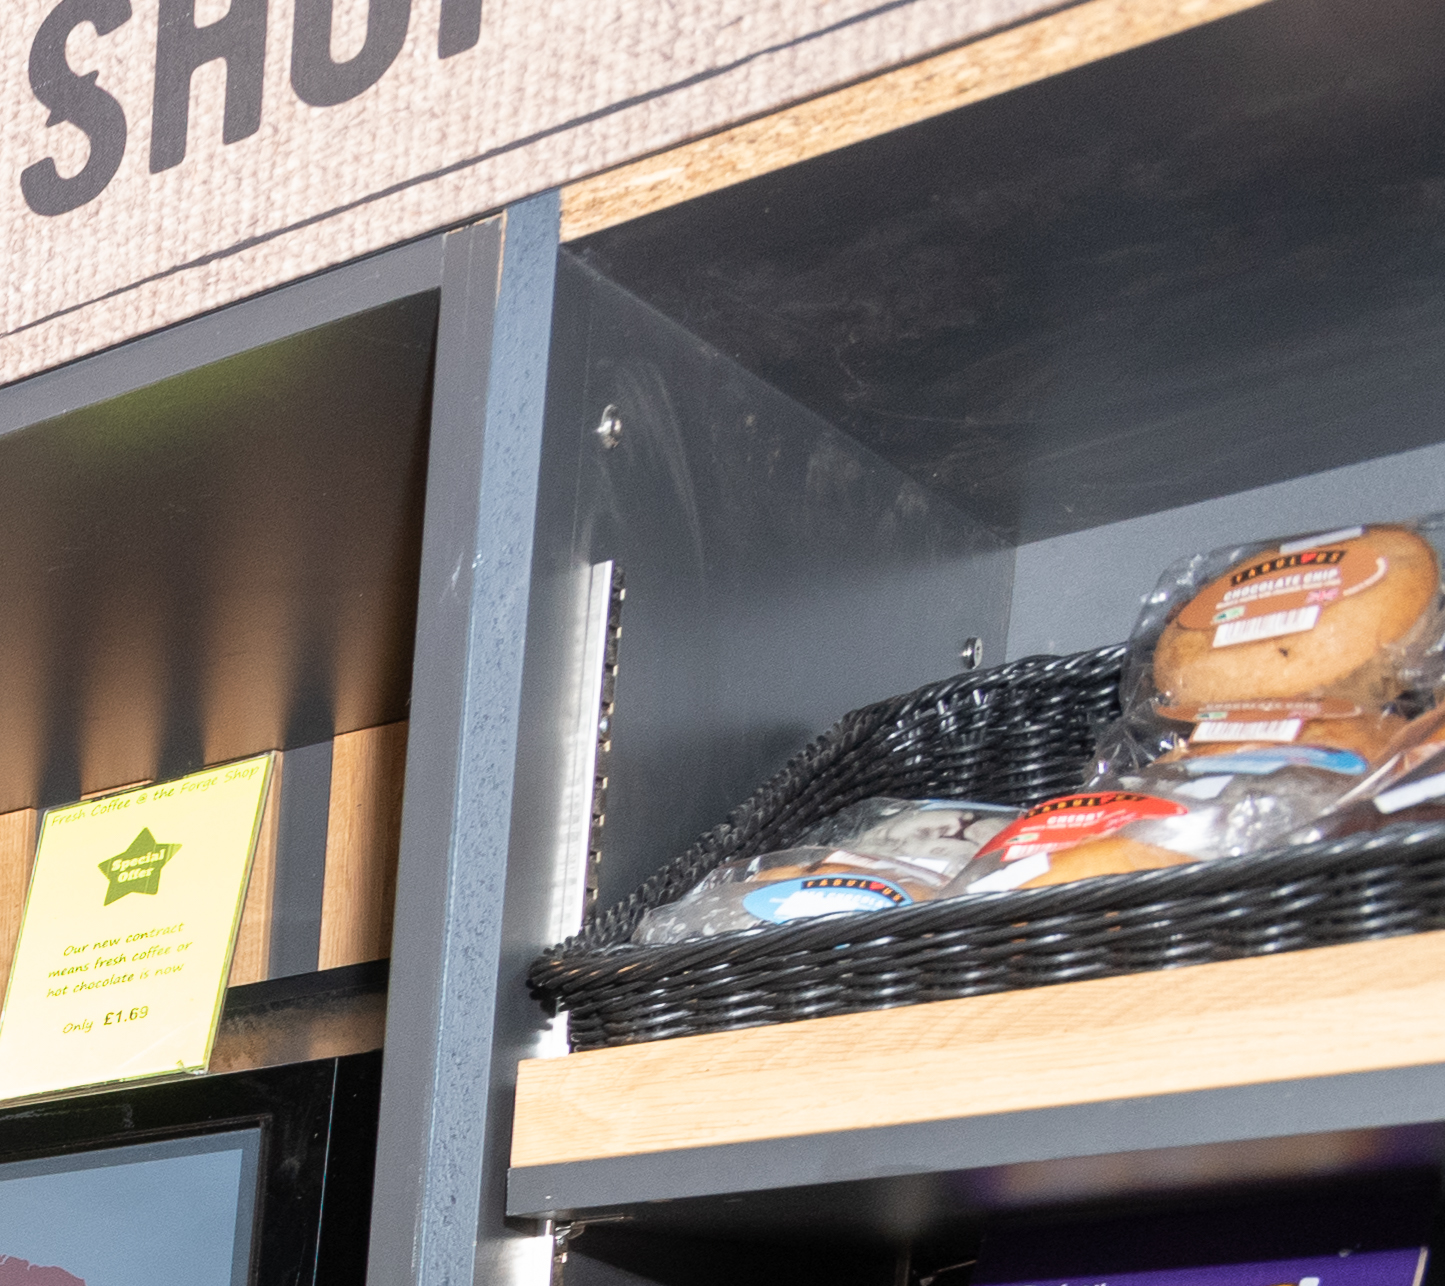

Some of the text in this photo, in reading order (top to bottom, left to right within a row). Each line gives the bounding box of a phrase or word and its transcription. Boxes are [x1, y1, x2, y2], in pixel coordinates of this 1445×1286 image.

[20, 0, 486, 217] SH
[50, 808, 86, 827] Fresh
[90, 798, 131, 818] Coffee
[153, 786, 175, 801] the
[180, 775, 219, 795] Forge
[223, 765, 261, 784] Shop
[110, 848, 166, 873] Special
[117, 866, 156, 884] Offer
[63, 922, 185, 957] Our new contract
[47, 940, 194, 979] means fresh coffee or
[46, 961, 185, 998] hot chocolate is now
[62, 1005, 150, 1035] Only £1.69
